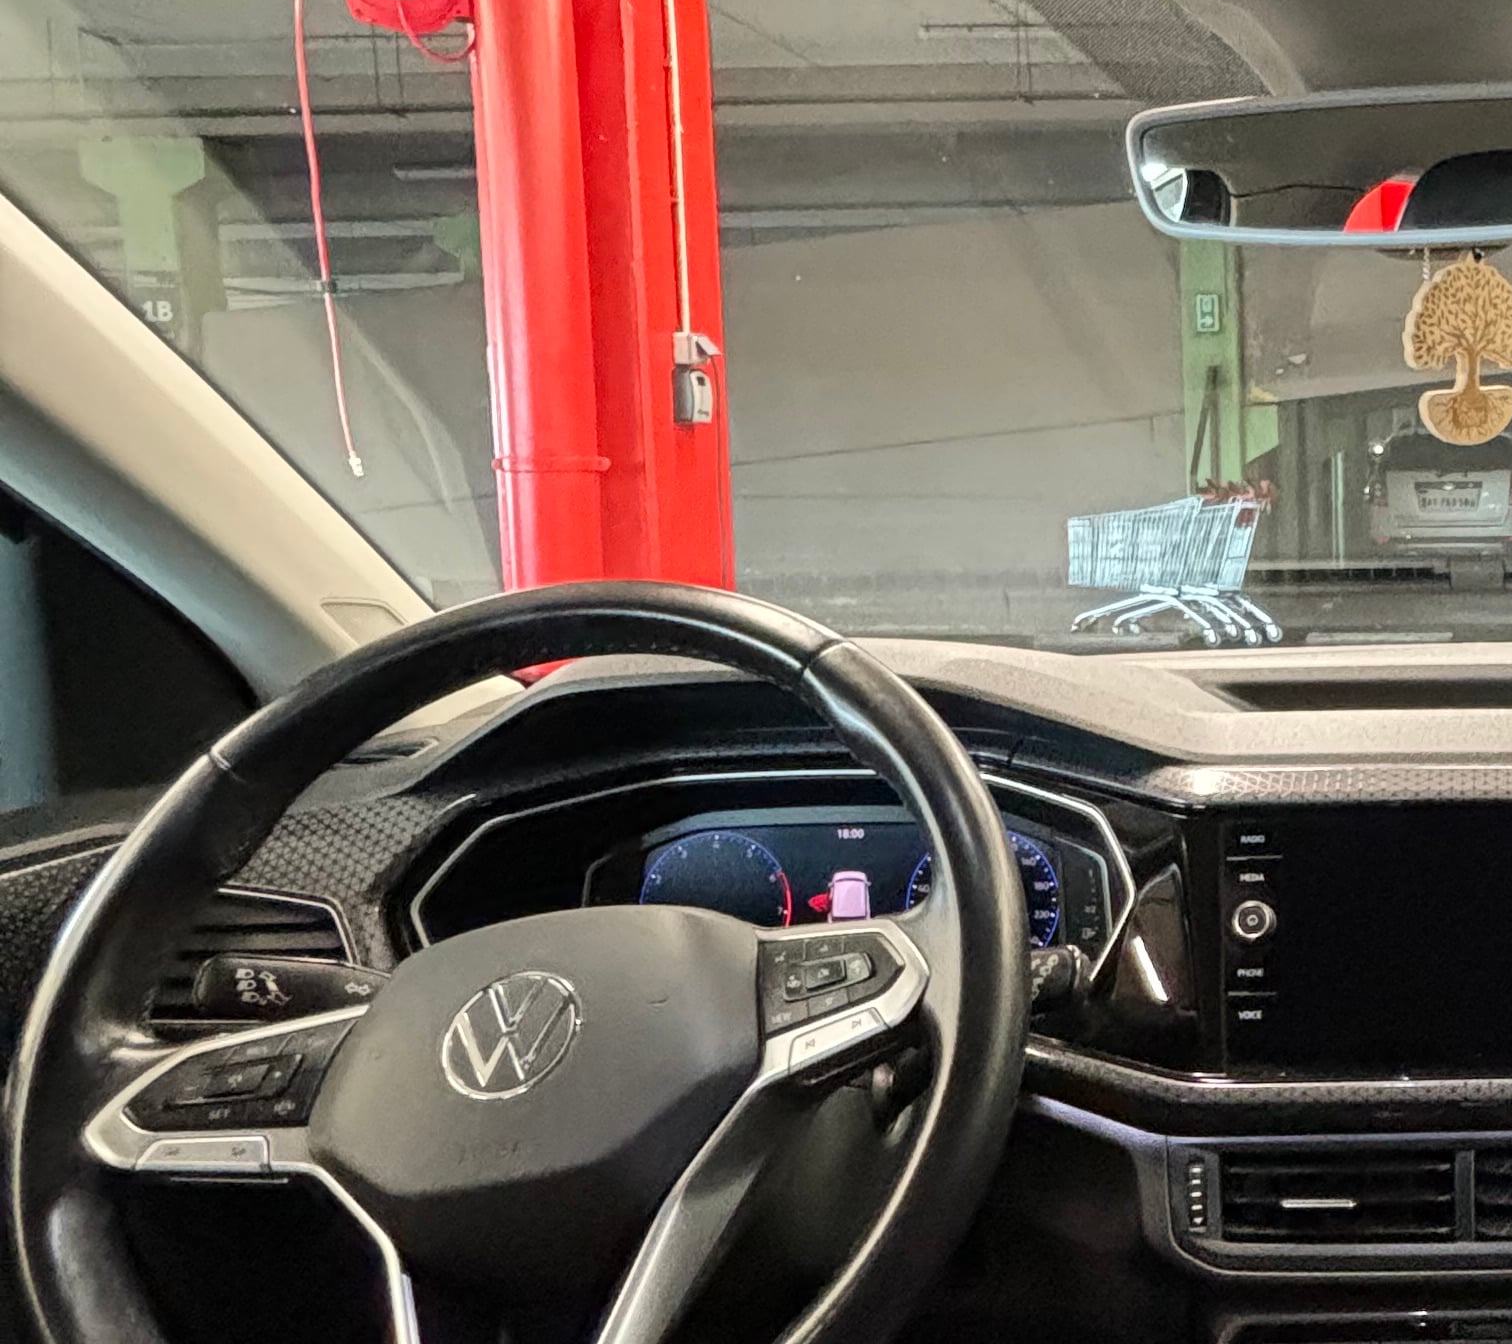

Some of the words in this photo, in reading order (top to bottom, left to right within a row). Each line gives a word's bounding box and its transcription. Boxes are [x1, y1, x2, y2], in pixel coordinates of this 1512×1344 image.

[1239, 872, 1265, 882] MEDIA
[1236, 967, 1265, 977] PHONE
[1238, 1009, 1263, 1019] VOICE
